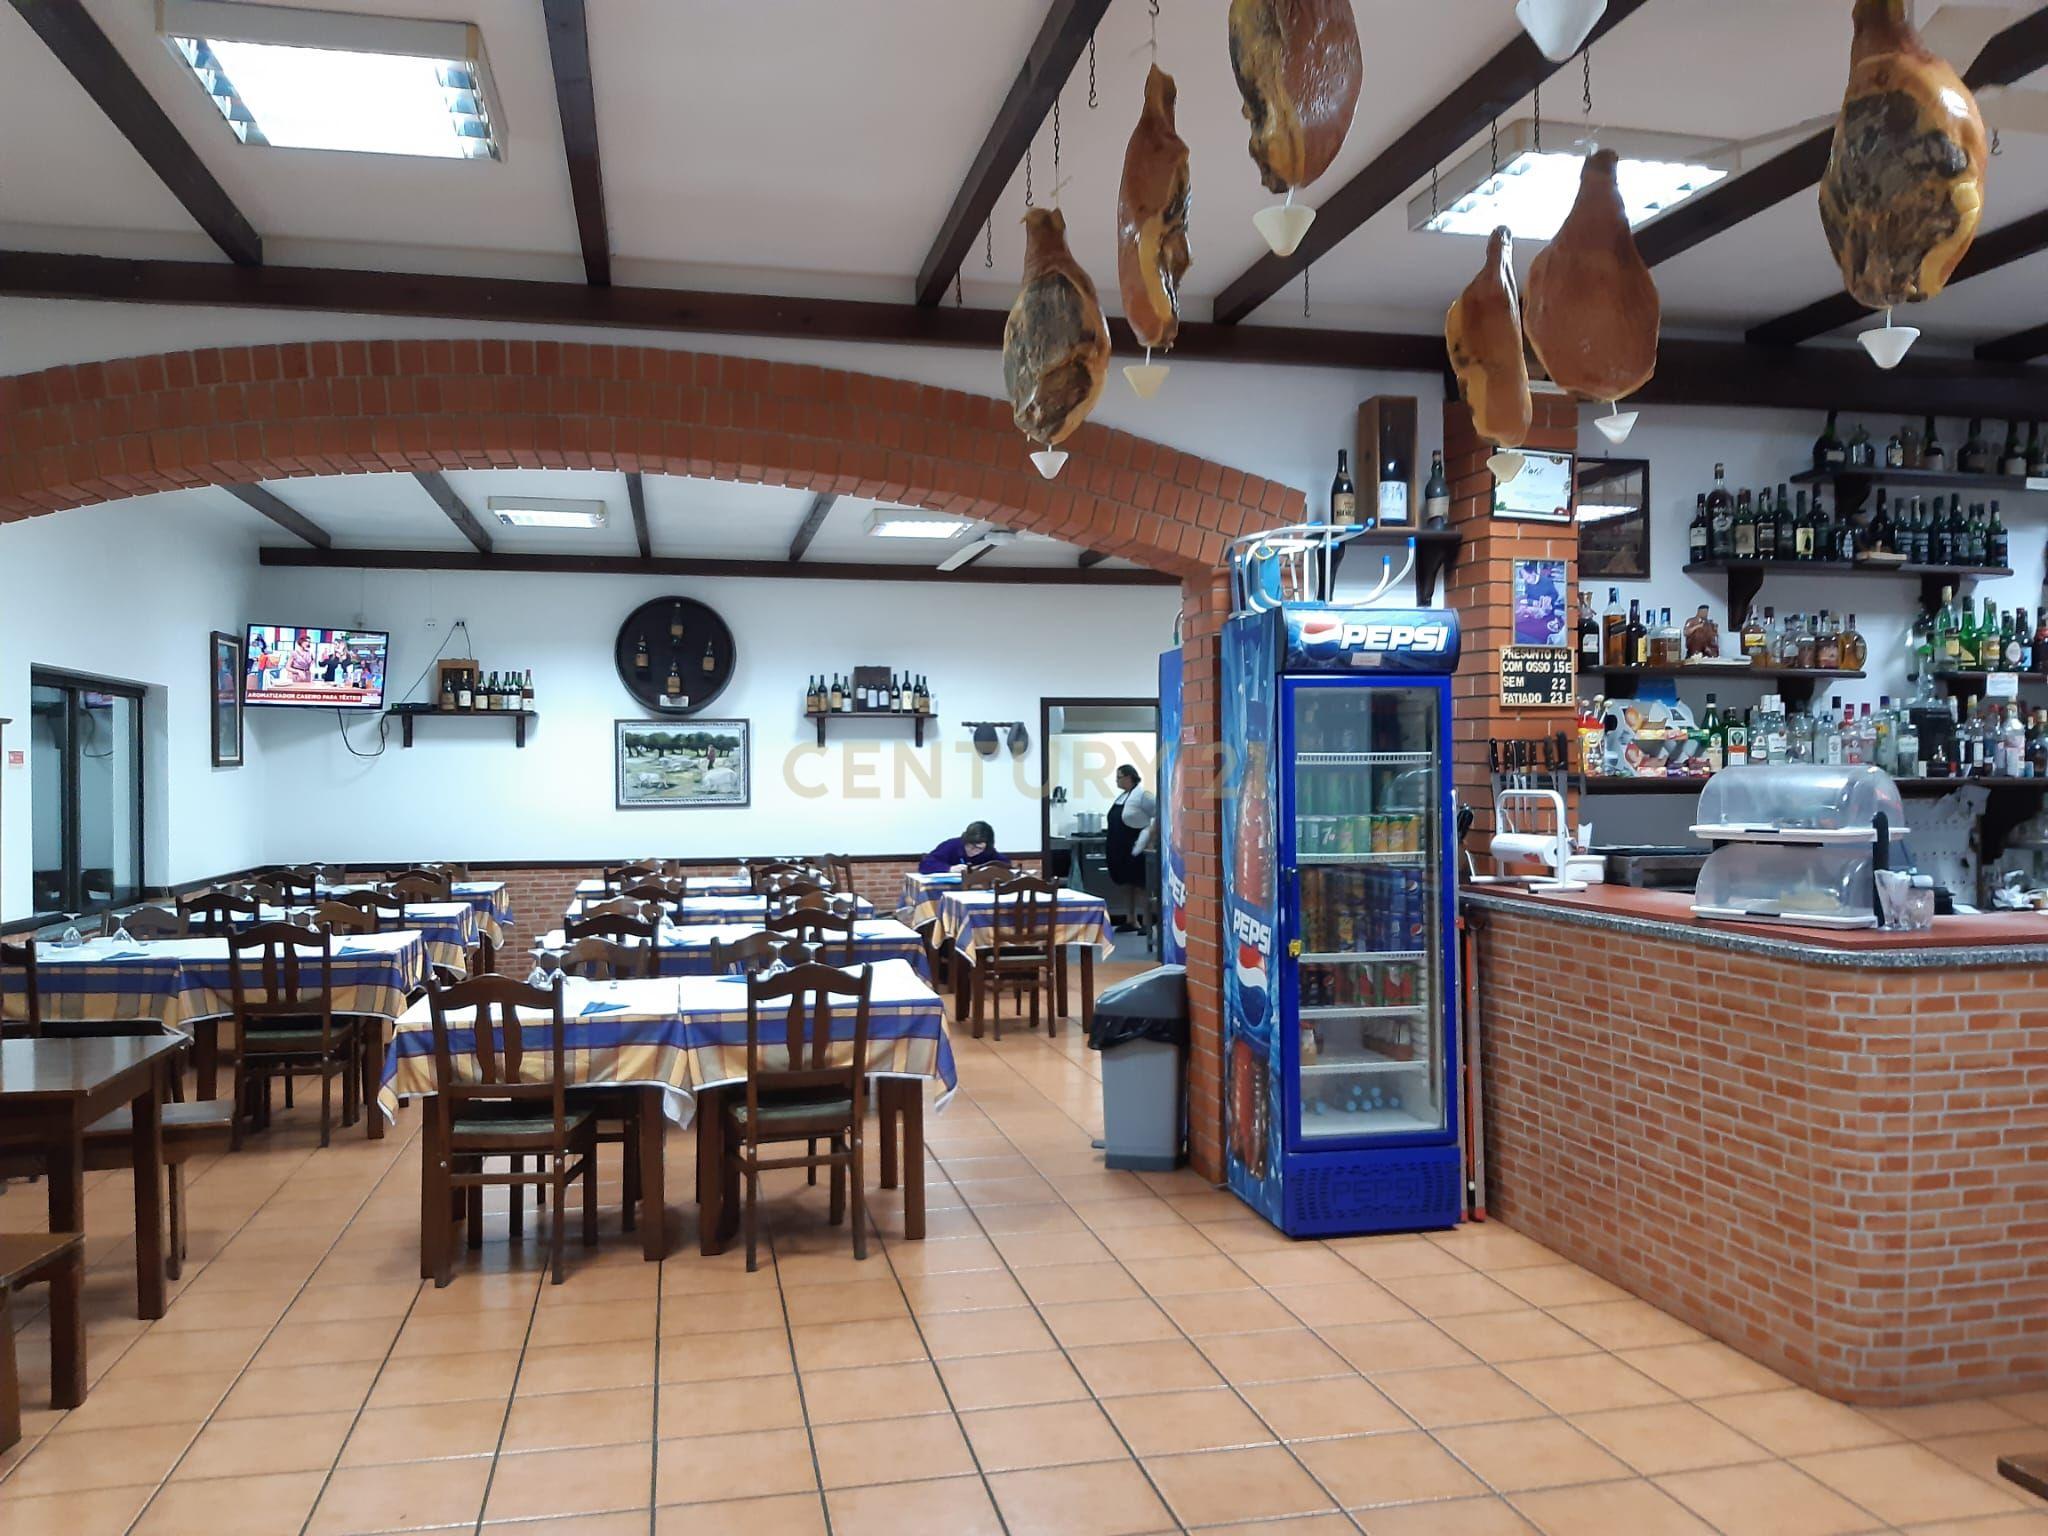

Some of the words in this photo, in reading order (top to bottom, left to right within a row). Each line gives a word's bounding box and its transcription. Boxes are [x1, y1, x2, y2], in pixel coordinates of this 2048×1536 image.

[1340, 624, 1449, 651] PEPSI
[1502, 648, 1551, 660] PRESUNTO
[1502, 660, 1523, 672] COM
[1526, 661, 1550, 673] OSSO
[1503, 676, 1525, 687] SEM
[1551, 678, 1566, 690] 22
[1503, 692, 1542, 703] FATIADO
[1233, 908, 1272, 956] PEPSI
[1333, 1176, 1420, 1204] PEPSI
